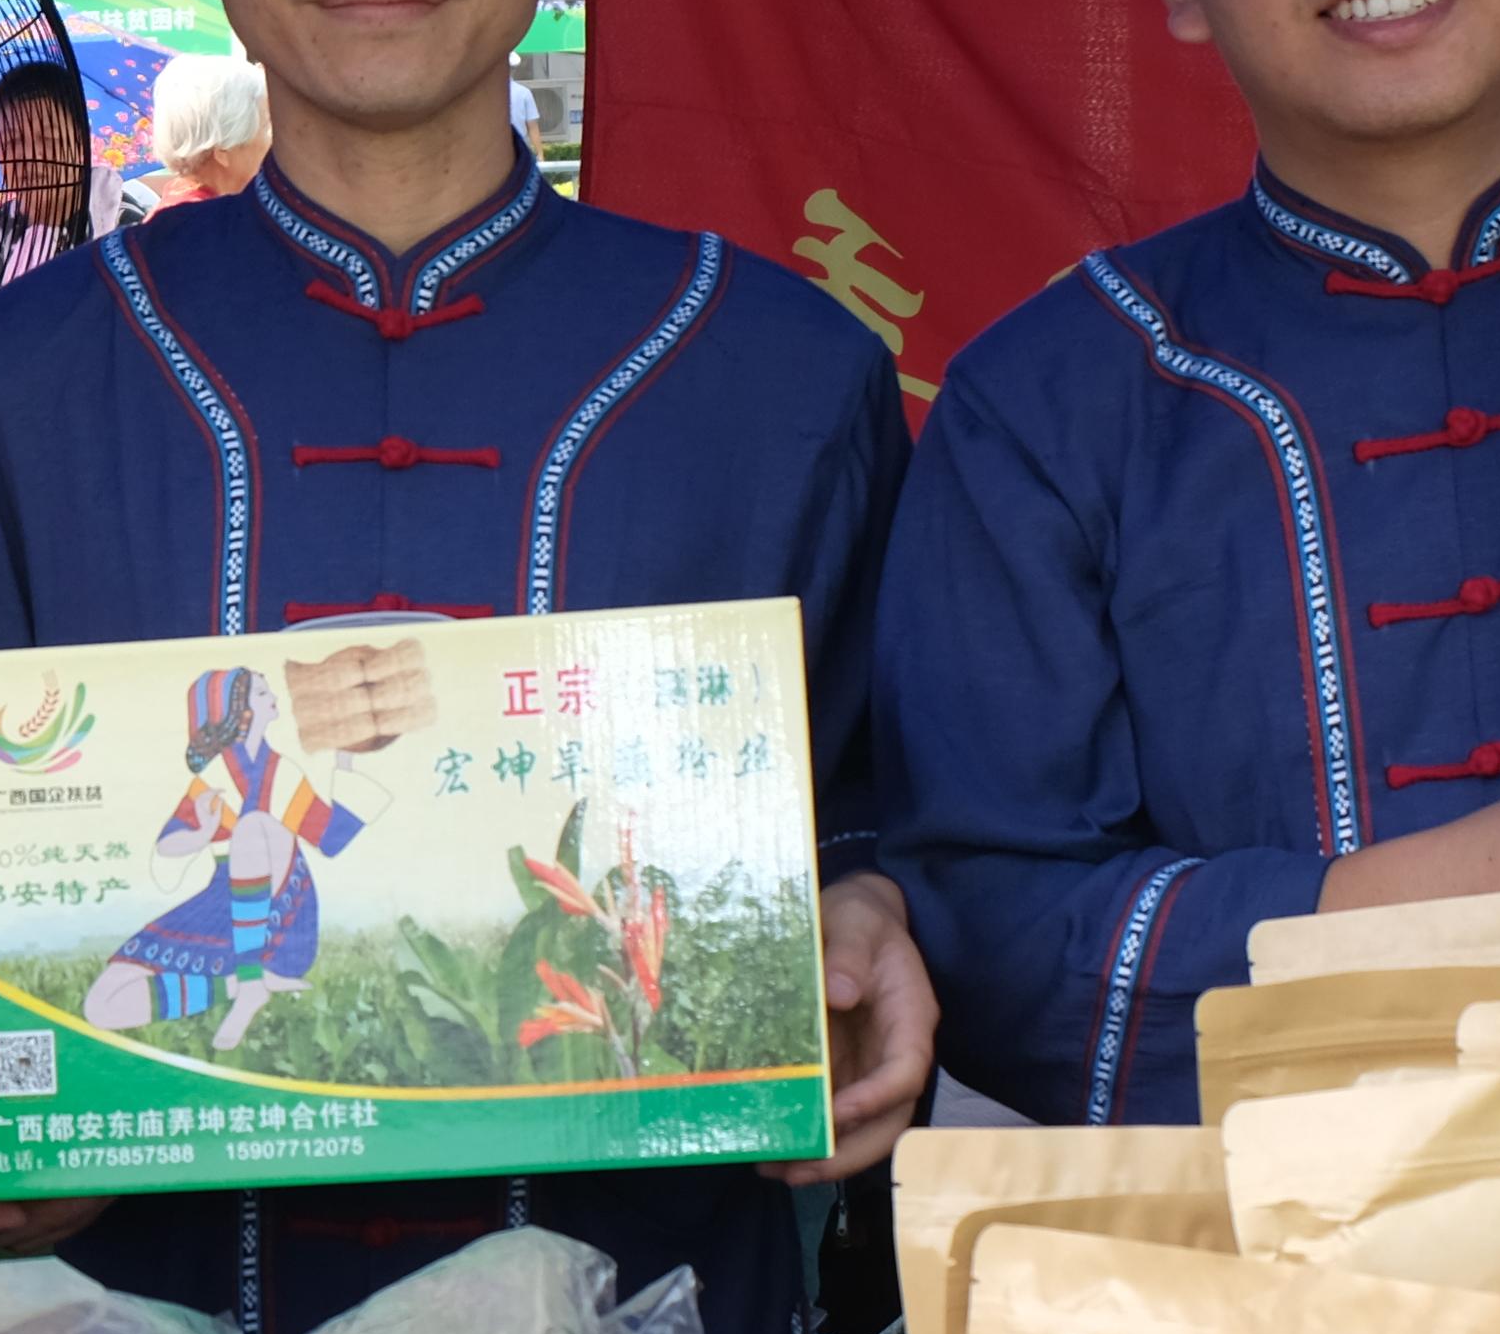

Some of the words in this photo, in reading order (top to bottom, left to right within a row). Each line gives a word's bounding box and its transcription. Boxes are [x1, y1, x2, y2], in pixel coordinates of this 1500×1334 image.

[502, 664, 598, 717] 正宗
[56, 1144, 195, 1169] 18775857588
[226, 1136, 365, 1161] 15907712075
